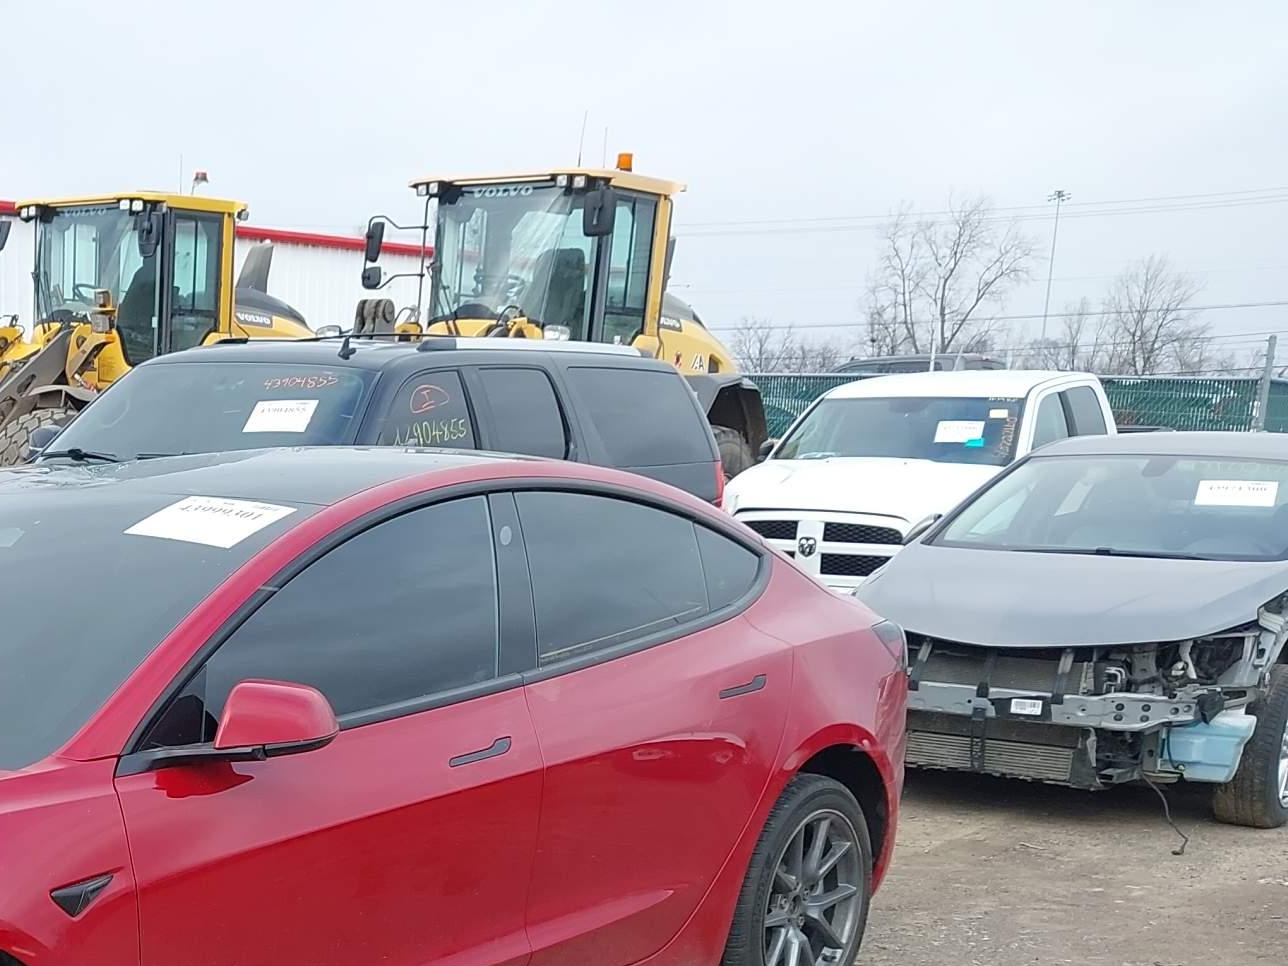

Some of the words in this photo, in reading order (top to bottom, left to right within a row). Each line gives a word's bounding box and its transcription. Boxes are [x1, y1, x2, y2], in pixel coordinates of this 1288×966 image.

[473, 185, 533, 198] VOLVO
[236, 312, 271, 325] VOLVO
[263, 375, 339, 391] 43904855
